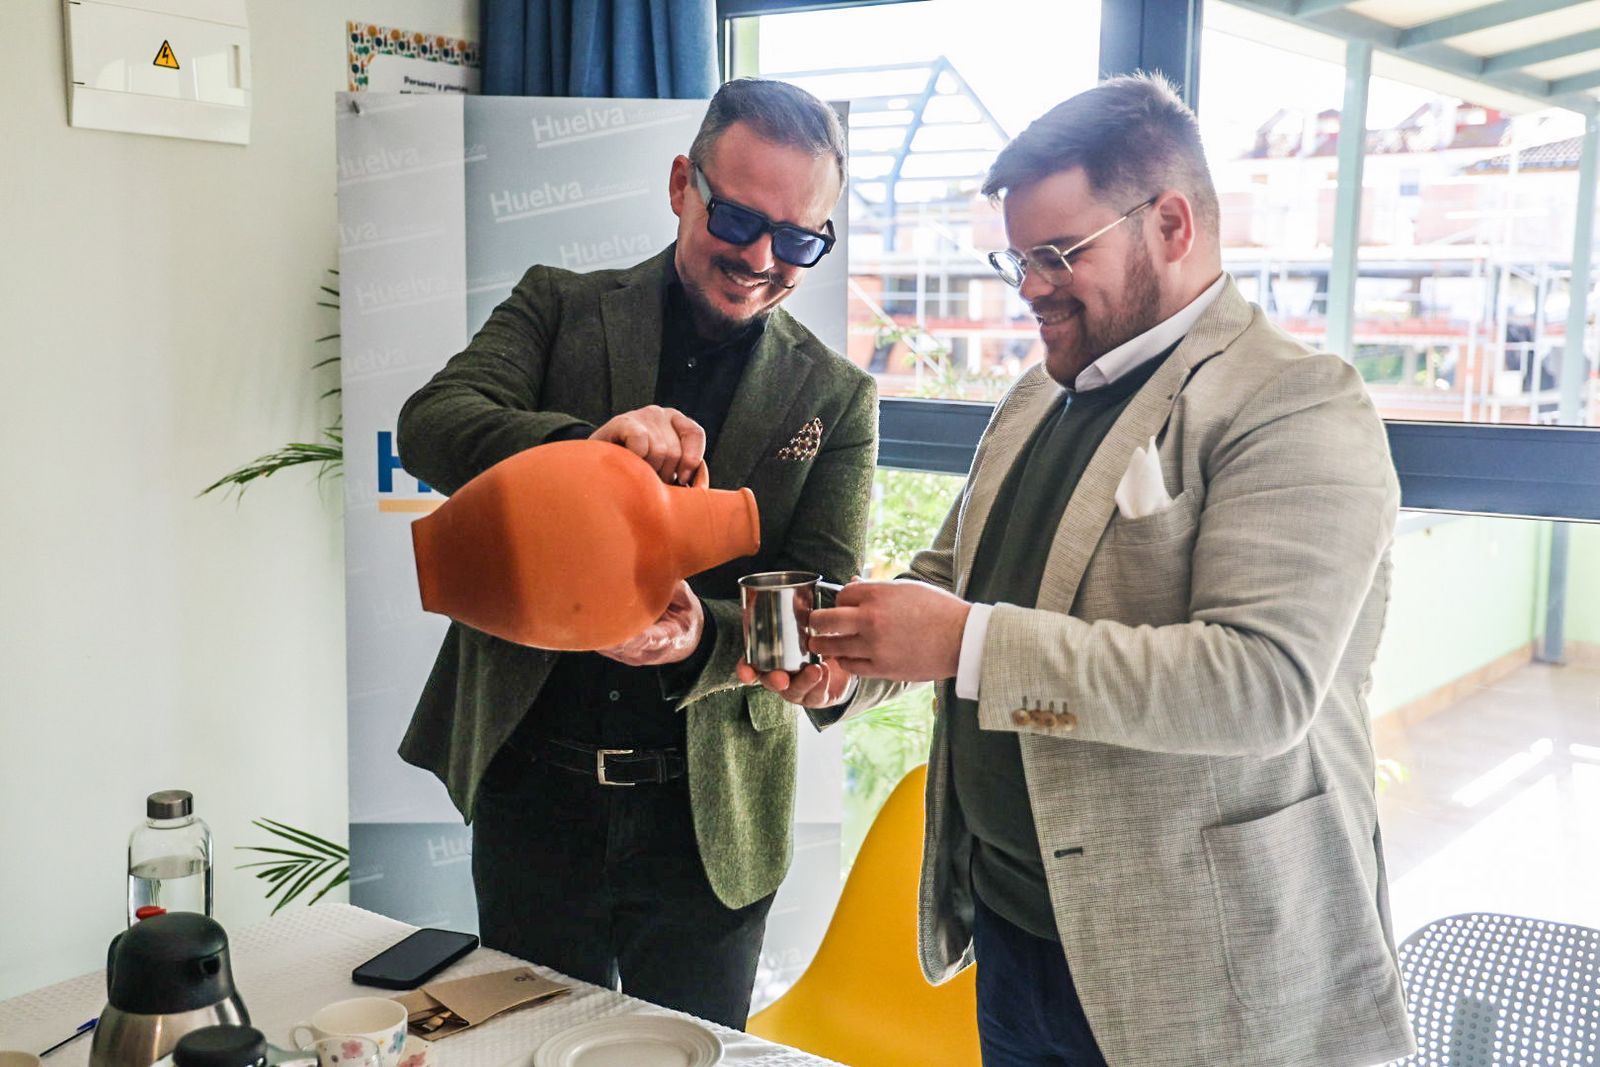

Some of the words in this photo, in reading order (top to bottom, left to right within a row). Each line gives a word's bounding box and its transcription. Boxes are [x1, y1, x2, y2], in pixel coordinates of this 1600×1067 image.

[531, 106, 626, 142] Huelva
[489, 180, 585, 216] Huelva
[338, 221, 378, 245] lva
[559, 232, 652, 268] Huelva
[355, 272, 450, 308] Huelva
